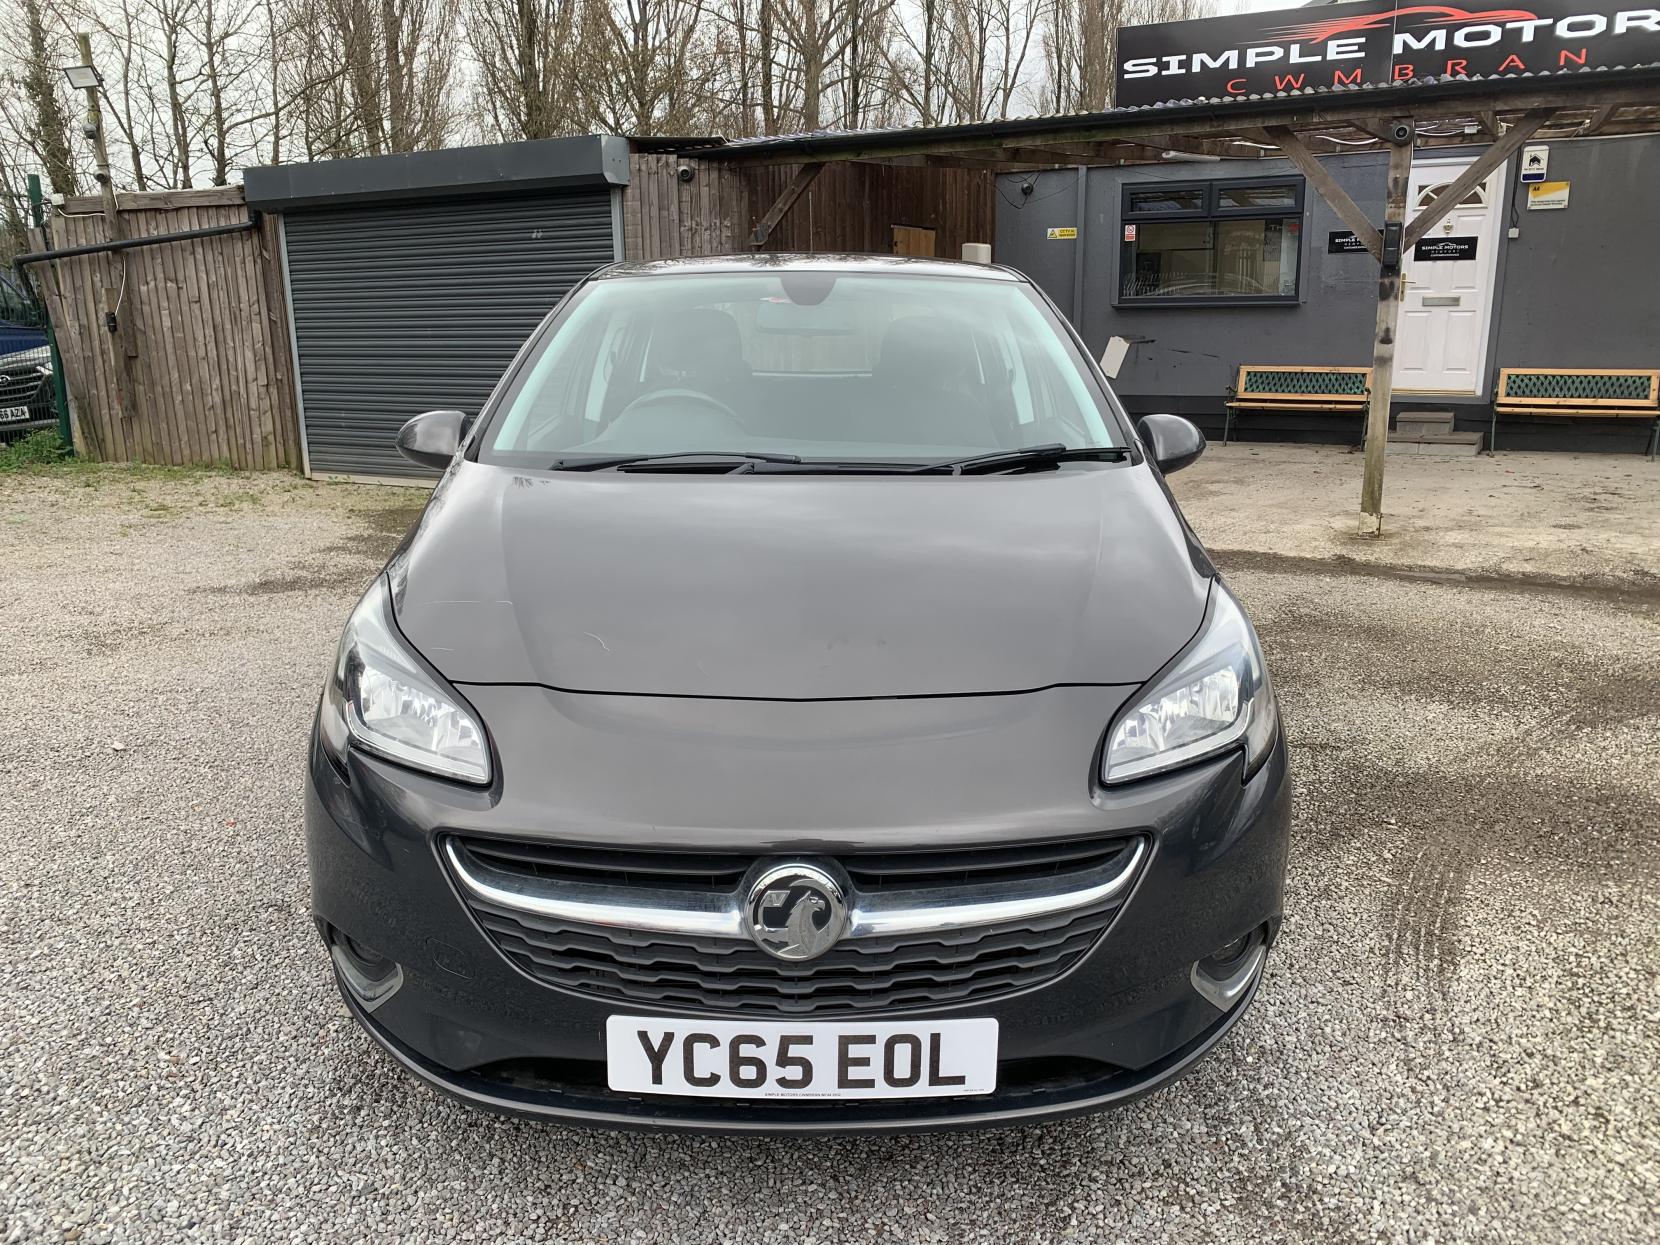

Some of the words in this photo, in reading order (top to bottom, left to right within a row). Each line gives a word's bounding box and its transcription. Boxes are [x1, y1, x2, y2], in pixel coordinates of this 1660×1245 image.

[1123, 37, 1366, 79] SIMPLE
[1226, 48, 1587, 93] CWMBRAN
[10, 407, 26, 418] AZA
[636, 1030, 814, 1089] YC65
[837, 1032, 966, 1088] EOL
